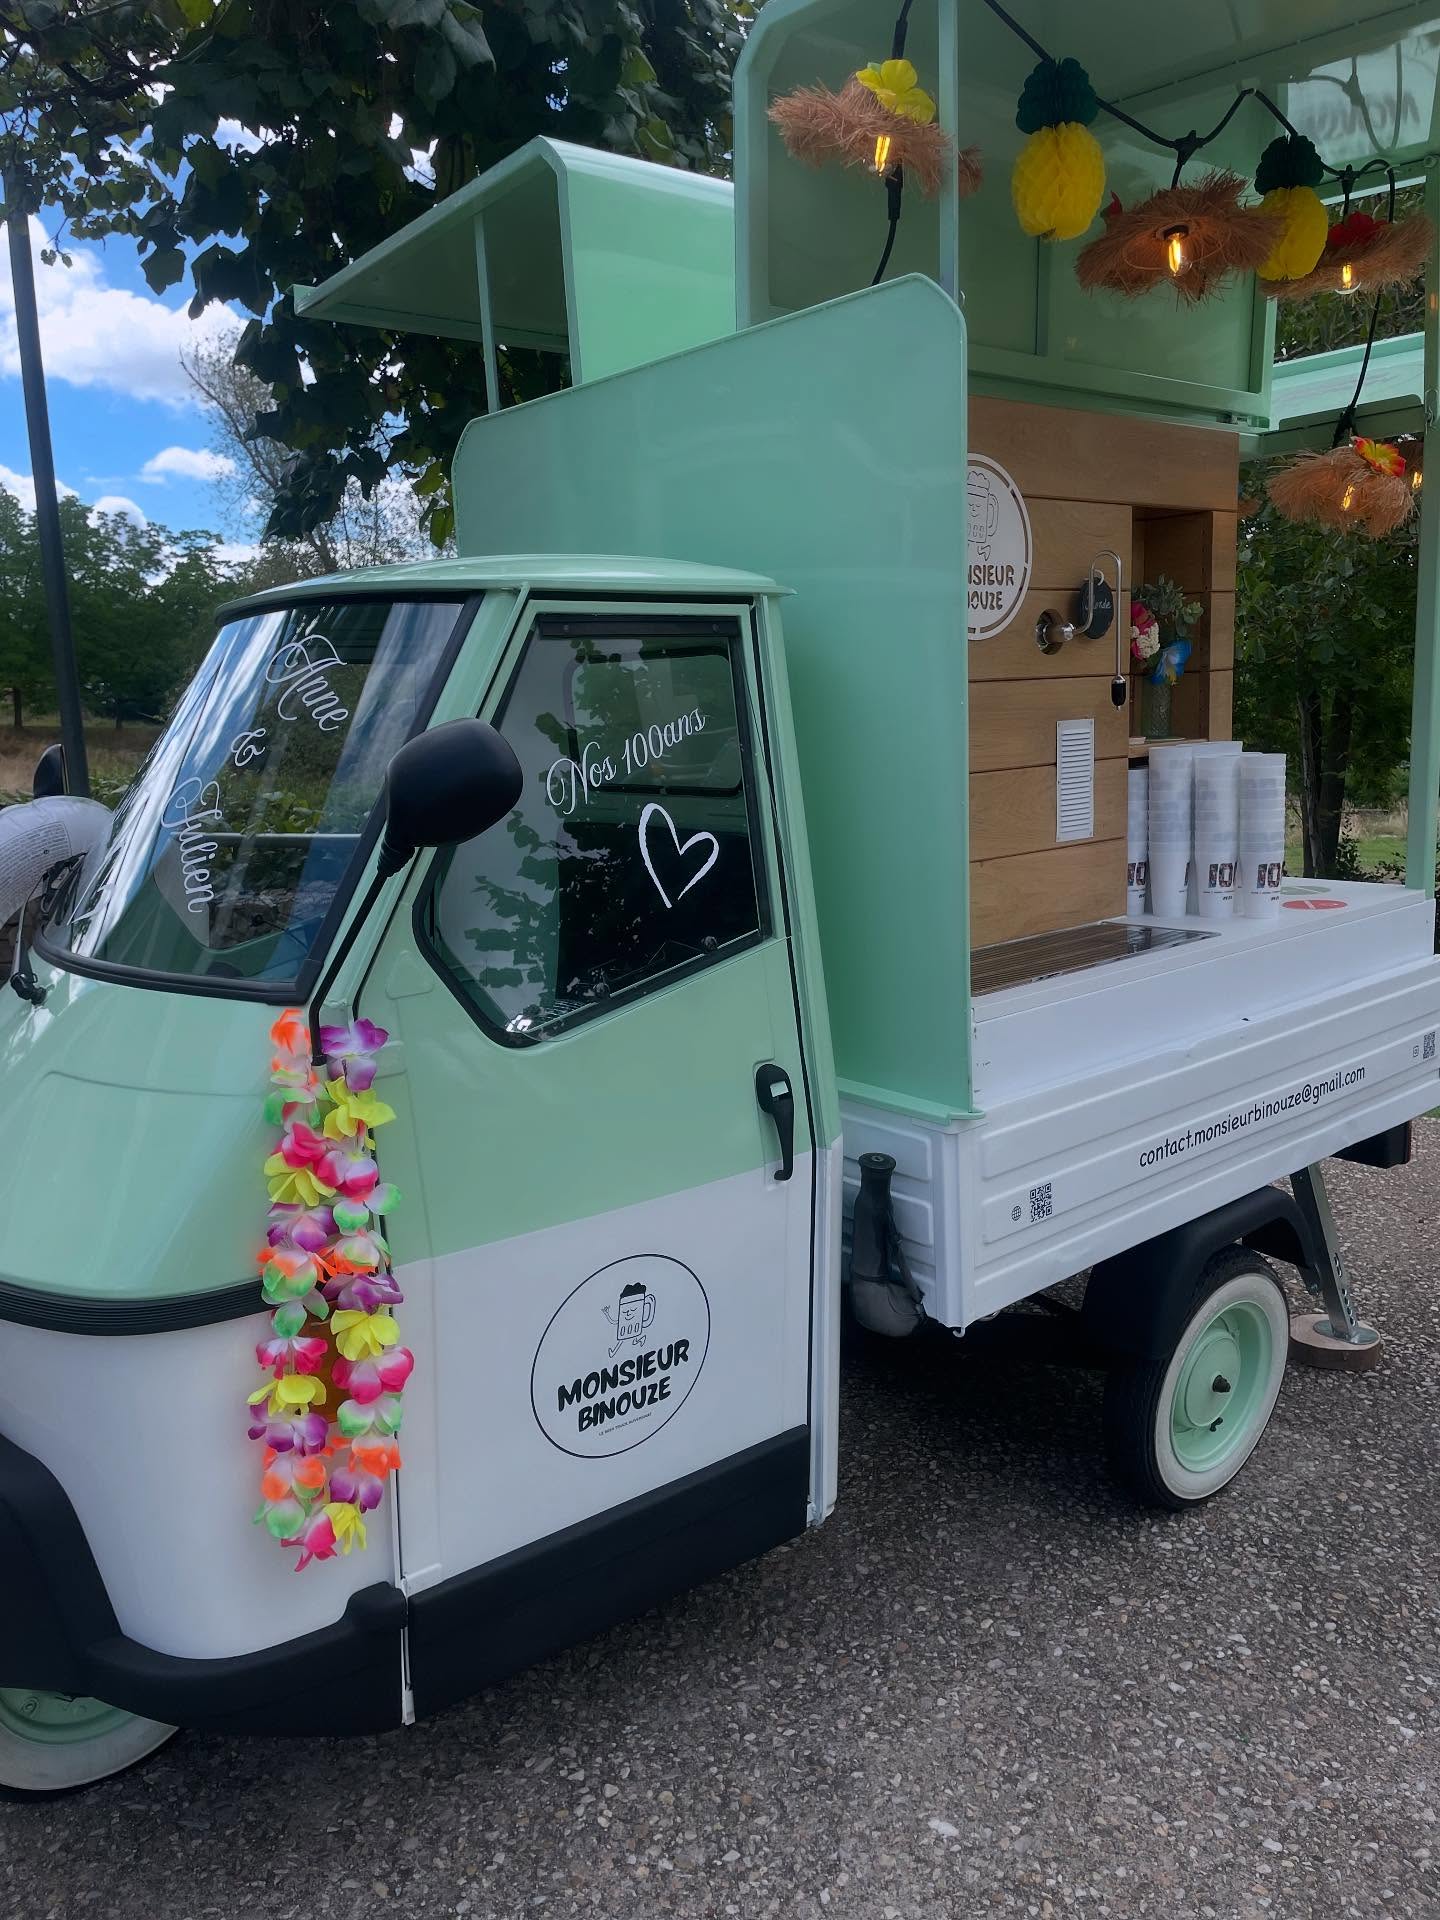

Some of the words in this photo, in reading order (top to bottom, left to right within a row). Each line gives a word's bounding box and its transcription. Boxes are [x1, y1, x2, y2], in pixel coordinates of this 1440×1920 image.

[967, 590, 1003, 610] OUZE
[265, 634, 348, 732] Anne
[546, 741, 617, 815] Nos
[161, 776, 223, 913] Julien
[1139, 1065, 1366, 1167] contact.monsieurbinouze@gmail.com
[557, 1338, 691, 1412] MONSIEUR
[578, 1375, 672, 1432] BINOUZE
